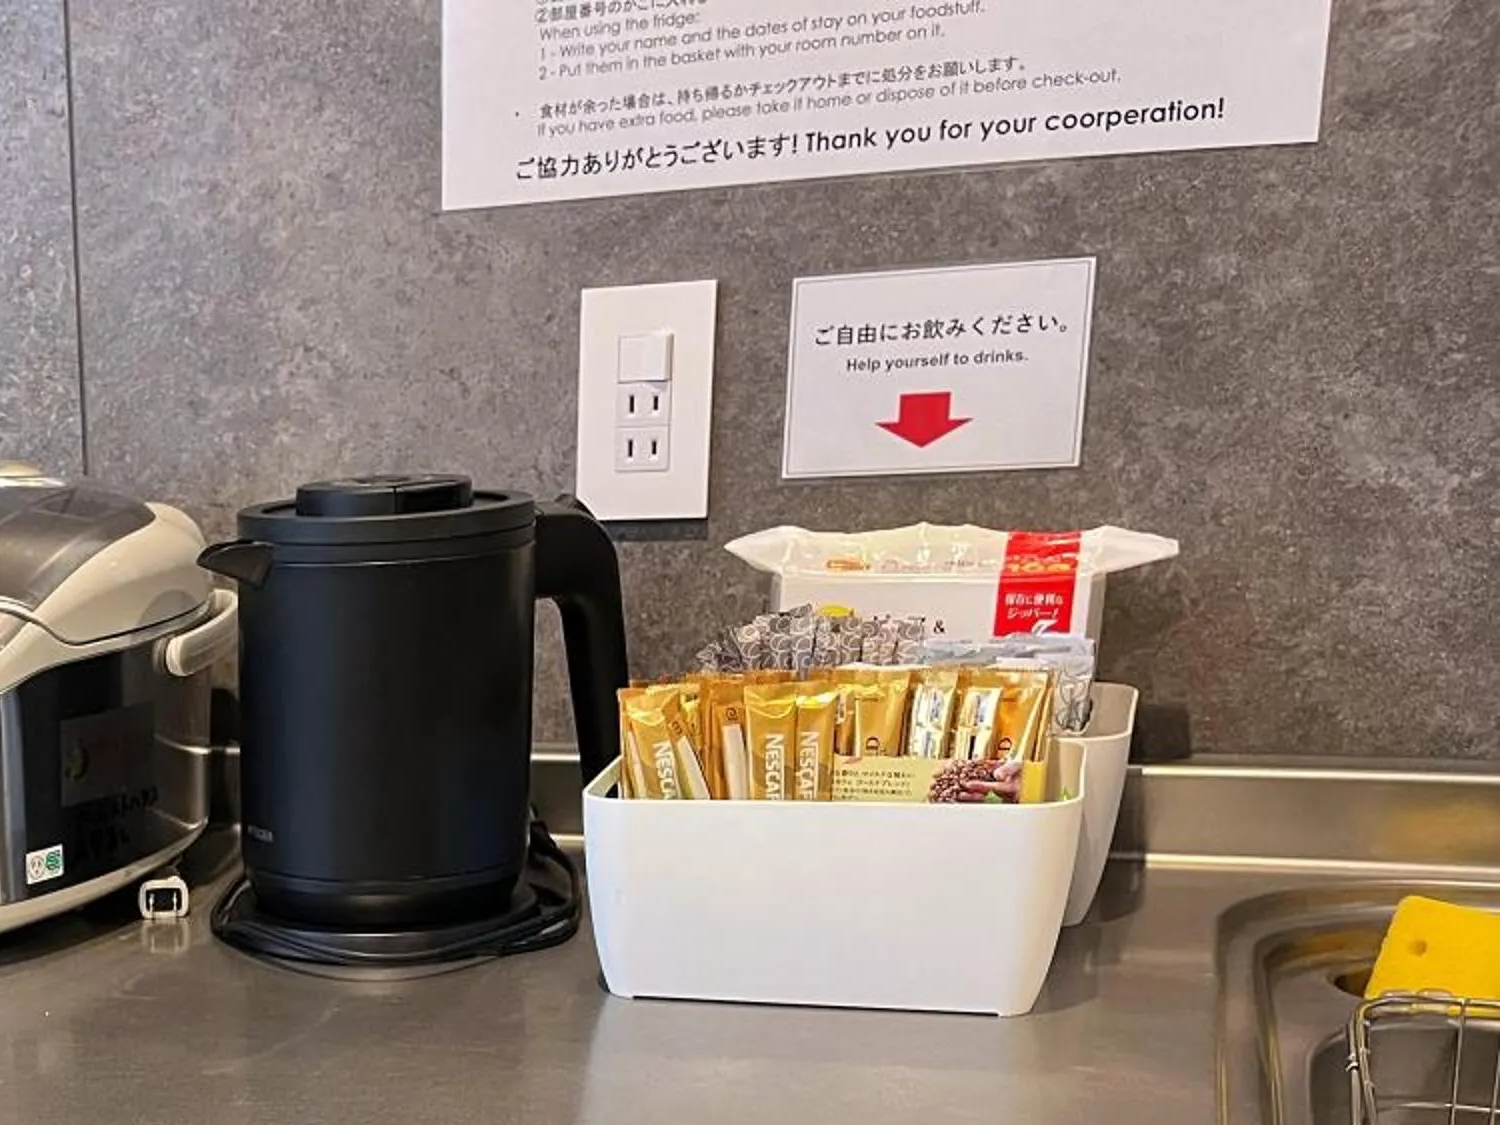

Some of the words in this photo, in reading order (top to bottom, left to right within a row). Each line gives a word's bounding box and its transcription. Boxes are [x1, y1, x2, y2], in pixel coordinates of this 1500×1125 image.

[538, 66, 547, 81] 2
[558, 63, 583, 78] Put
[585, 58, 623, 74] them
[626, 55, 640, 70] in
[643, 52, 667, 68] the
[670, 48, 720, 66] basket
[722, 43, 756, 59] with
[758, 41, 791, 59] your
[795, 36, 837, 52] room
[840, 29, 903, 47] number
[906, 26, 928, 41] on
[931, 23, 946, 38] it.
[539, 26, 580, 41] When
[583, 22, 621, 38] using
[625, 16, 649, 30] the
[559, 44, 596, 58] Write
[599, 40, 630, 58] your
[633, 33, 678, 49] name
[681, 28, 712, 44] and
[716, 25, 741, 39] the
[744, 21, 789, 38] dates
[791, 17, 808, 32] of
[812, 14, 843, 31] stay
[846, 13, 867, 26] on
[871, 9, 906, 25] your
[536, 123, 546, 137] If
[549, 121, 576, 139] you
[578, 117, 615, 133] have
[618, 113, 656, 129] extra
[701, 103, 751, 122] please
[755, 98, 789, 115] take
[793, 97, 803, 112] it
[806, 92, 852, 110] home
[855, 90, 873, 106] or
[875, 85, 935, 105] dispose
[939, 80, 956, 97] of
[959, 79, 969, 95] it
[973, 75, 1028, 94] before
[515, 132, 798, 180] ご協力ありがとうございます!
[804, 128, 877, 154] Thank
[884, 124, 932, 149] you
[938, 118, 972, 141] for
[980, 115, 1037, 142] your
[1044, 97, 1225, 133] coorperation!
[814, 312, 1068, 347] ご自由にお飲みください。
[846, 357, 881, 373] Help
[885, 352, 949, 374] yourself
[953, 353, 969, 366] to
[973, 350, 1029, 366] drinks.
